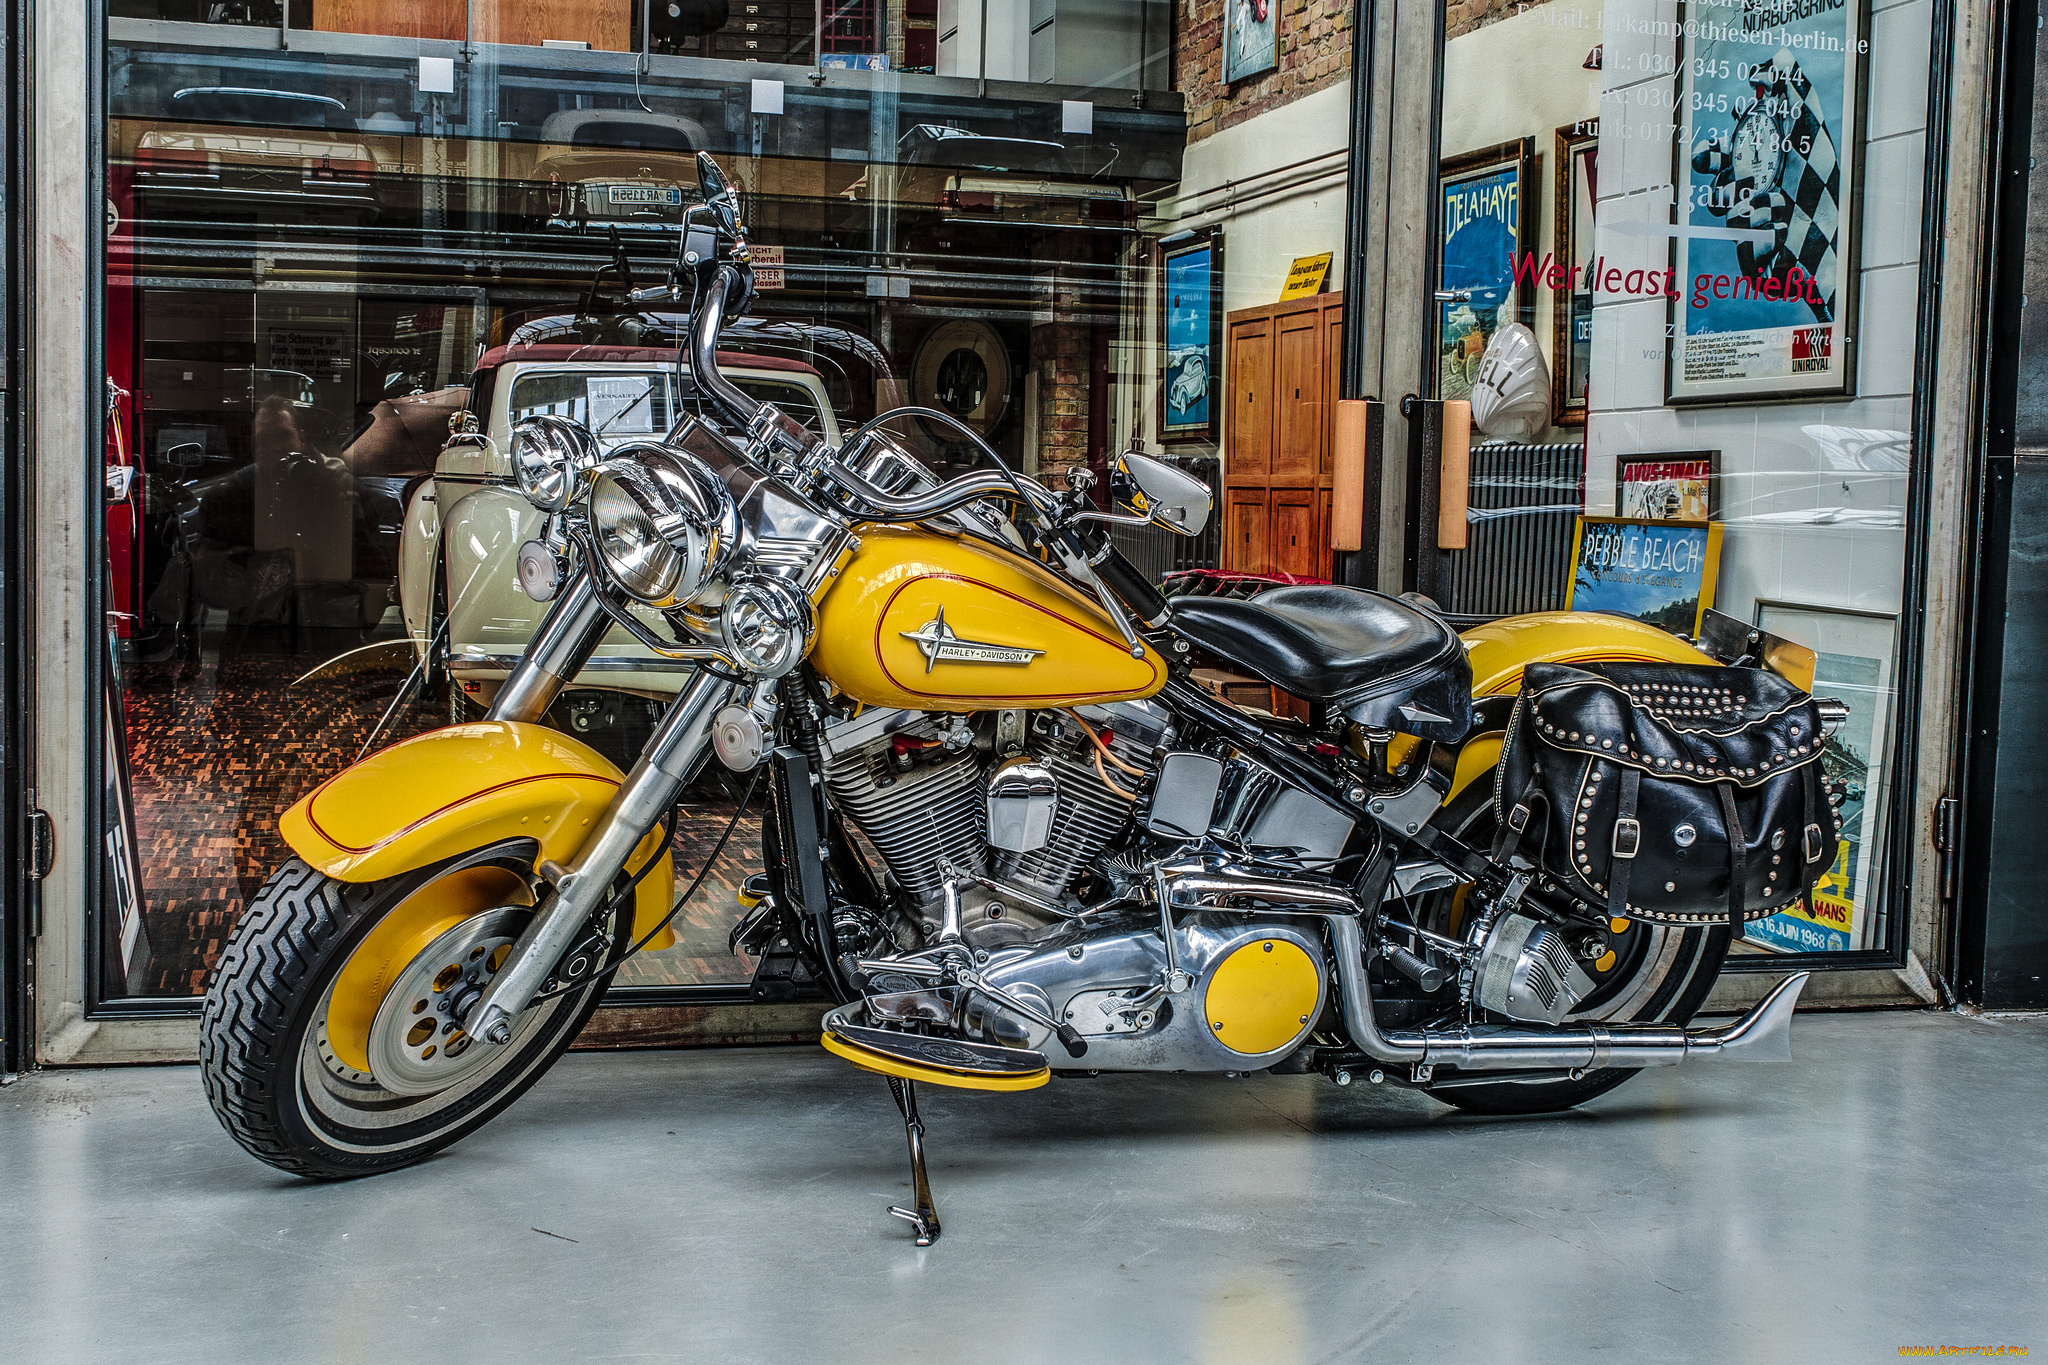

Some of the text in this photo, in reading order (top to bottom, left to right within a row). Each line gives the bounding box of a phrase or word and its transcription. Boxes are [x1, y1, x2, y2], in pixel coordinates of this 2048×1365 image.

[1693, 58, 1730, 79] 345
[1737, 62, 1760, 82] 02
[1767, 65, 1804, 86] 044
[1691, 92, 1728, 113] 345
[1735, 96, 1758, 116] 02
[1765, 99, 1802, 120] 046
[1446, 181, 1517, 245] DELAHAYE
[755, 270, 780, 280] SSER
[1508, 251, 1824, 309] Wer least, genießt.
[1584, 533, 1700, 574] PEBBLE BEACH
[941, 647, 1023, 661] HARLEY-DAVIDSON
[1814, 899, 1847, 923] MANS
[1764, 918, 1776, 933] 16
[1775, 922, 1799, 940] JUIN
[1800, 926, 1825, 949] 1968
